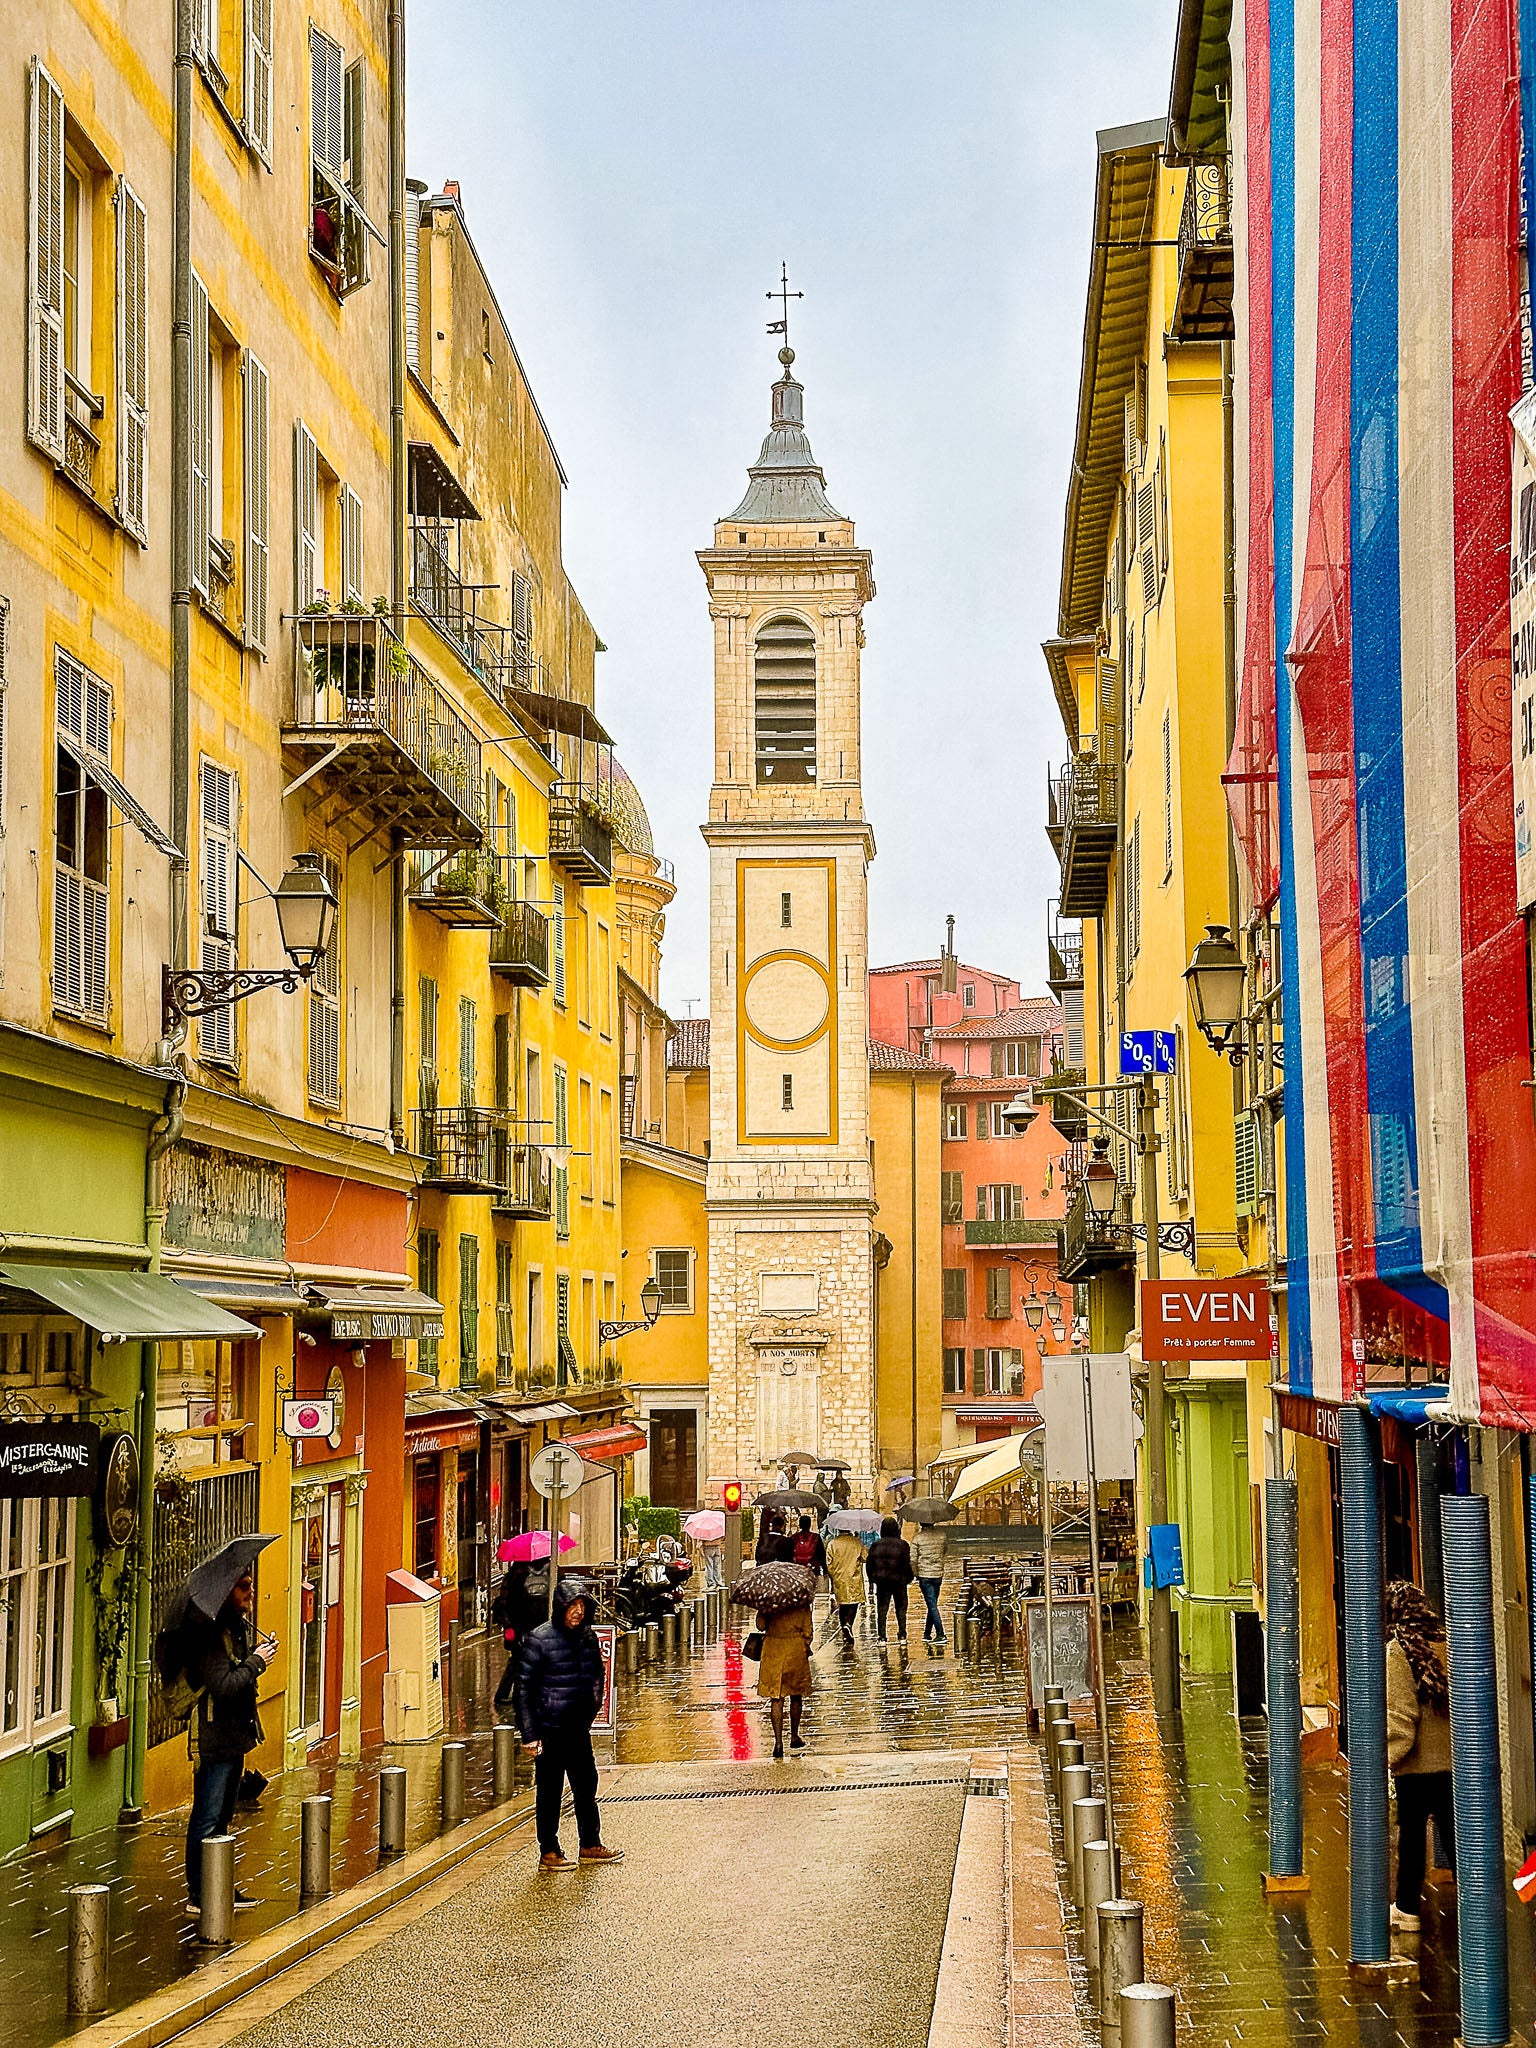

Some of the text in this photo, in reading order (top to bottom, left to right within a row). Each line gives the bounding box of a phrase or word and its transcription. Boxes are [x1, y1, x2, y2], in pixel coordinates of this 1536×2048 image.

[1123, 1033, 1153, 1072] SOS
[1157, 1032, 1174, 1074] SOS
[1161, 1292, 1255, 1322] EVEN
[399, 1316, 411, 1337] BAR
[1163, 1337, 1256, 1348] Prêt à porter Femme
[761, 1349, 815, 1358] A NOS MORTS
[11, 1464, 23, 1473] LES
